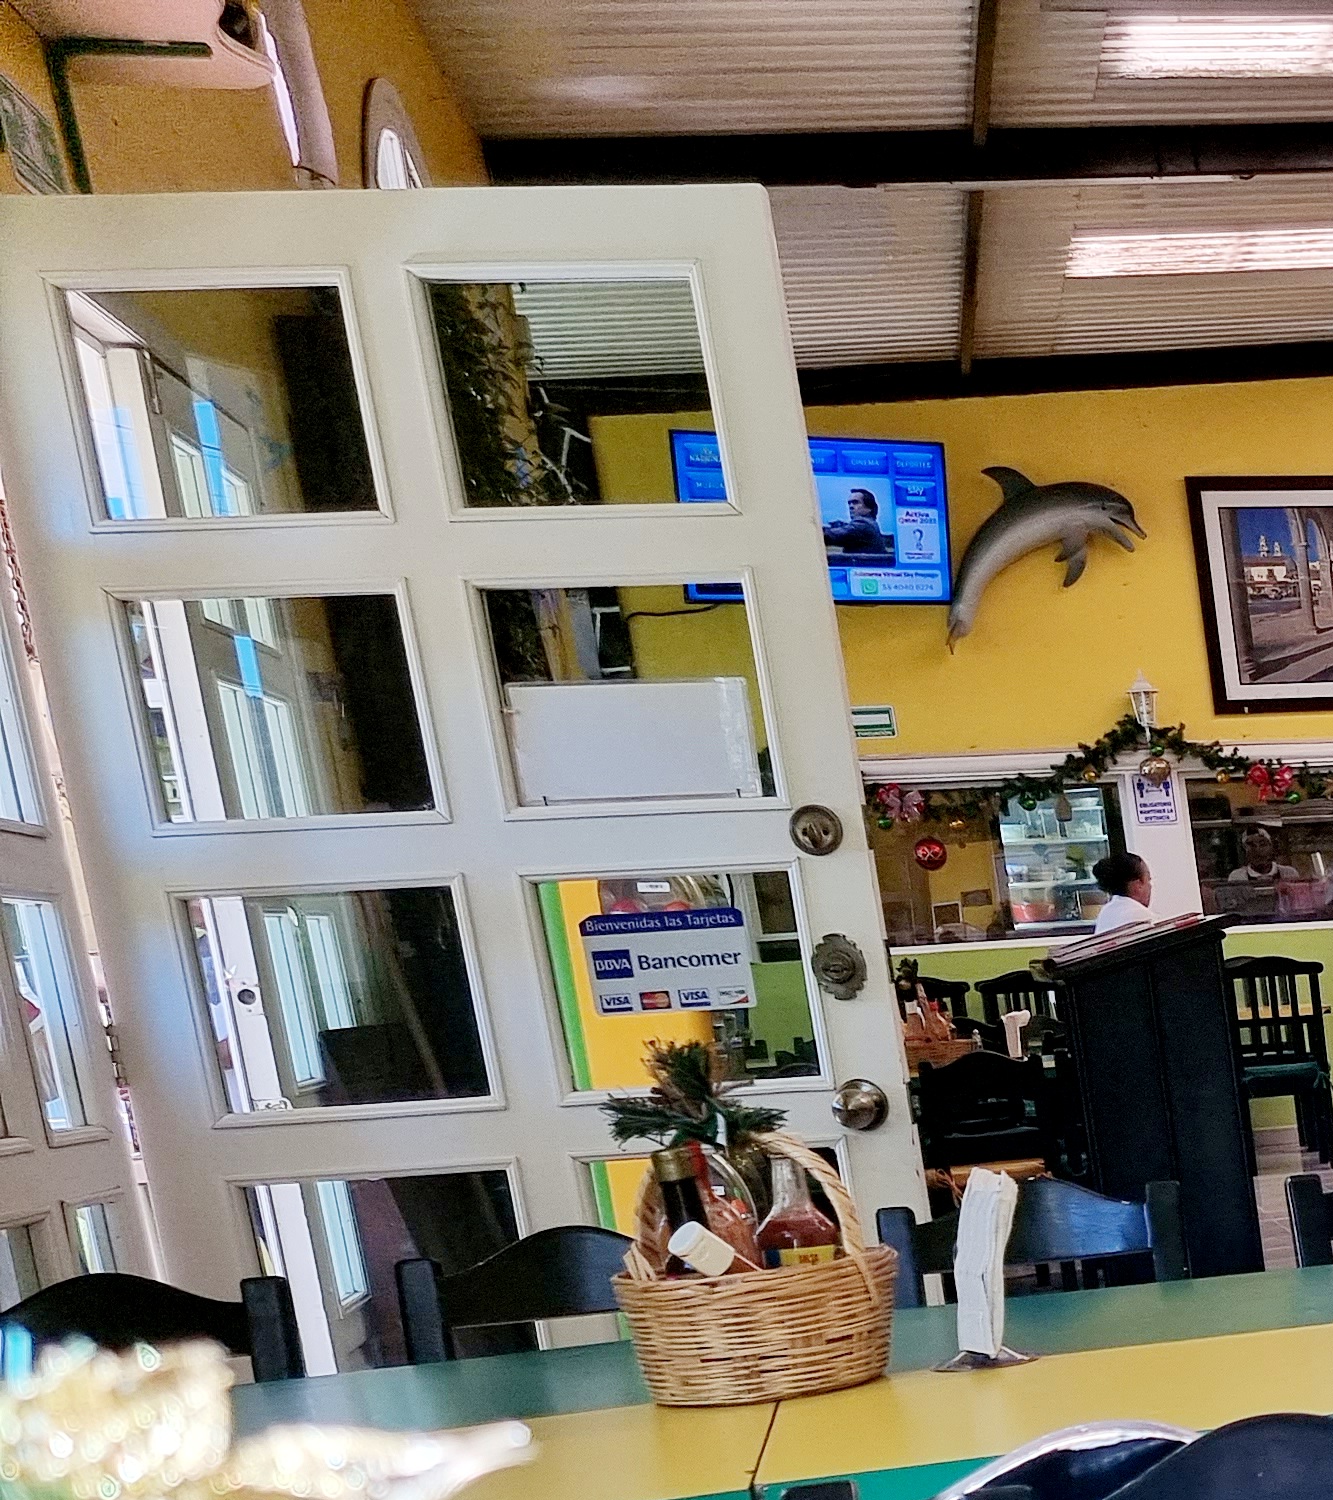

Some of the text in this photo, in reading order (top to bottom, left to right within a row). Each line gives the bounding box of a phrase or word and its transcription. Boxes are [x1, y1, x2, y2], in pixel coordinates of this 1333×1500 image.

[586, 913, 735, 932] Bienvenidas las Tarjetas
[595, 951, 741, 972] BBVA Bancomer
[604, 996, 631, 1006] VISA
[682, 990, 709, 1000] VISA
